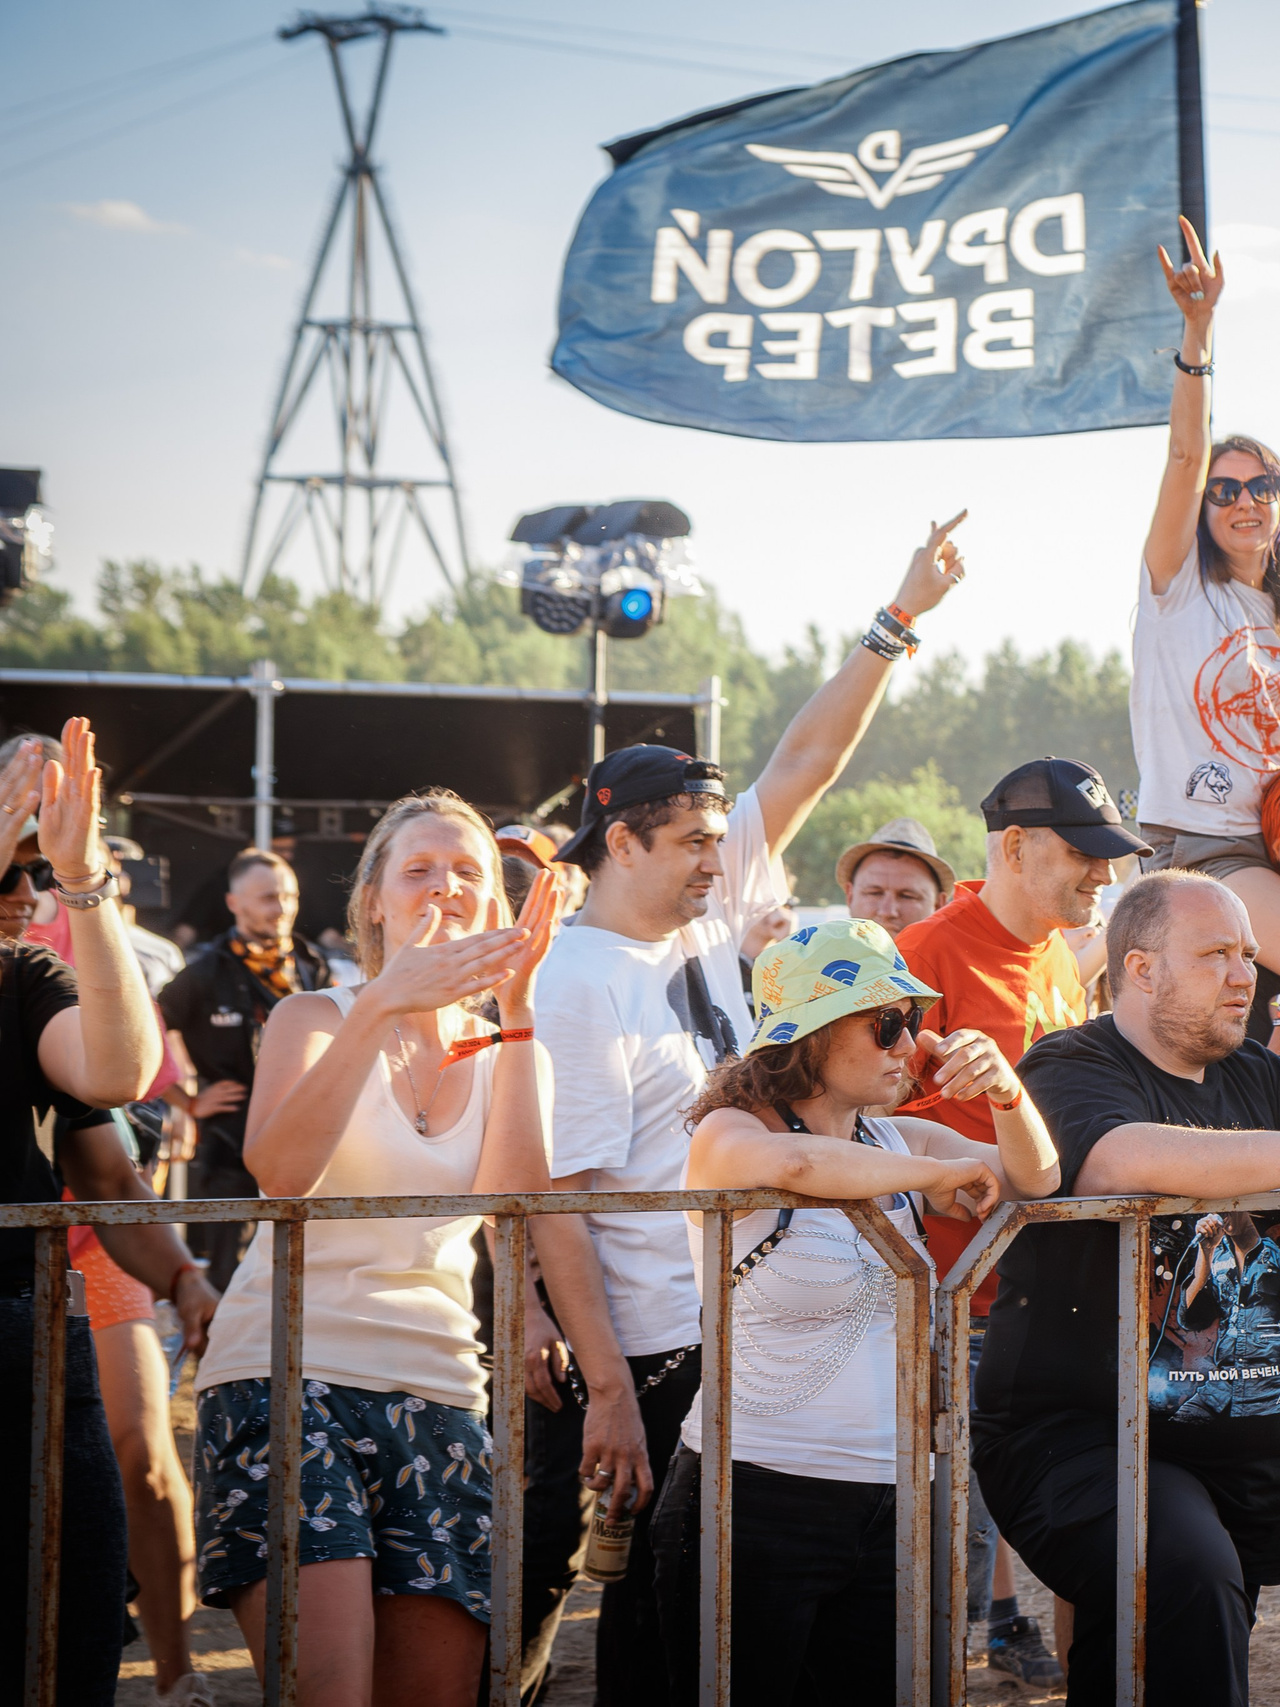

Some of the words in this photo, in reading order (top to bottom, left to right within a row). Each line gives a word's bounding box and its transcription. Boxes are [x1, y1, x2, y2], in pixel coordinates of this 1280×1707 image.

[863, 979, 884, 993] THE
[853, 985, 897, 1007] NORTH
[1168, 1371, 1204, 1382] ПУТЬ
[1208, 1367, 1239, 1381] МОЙ
